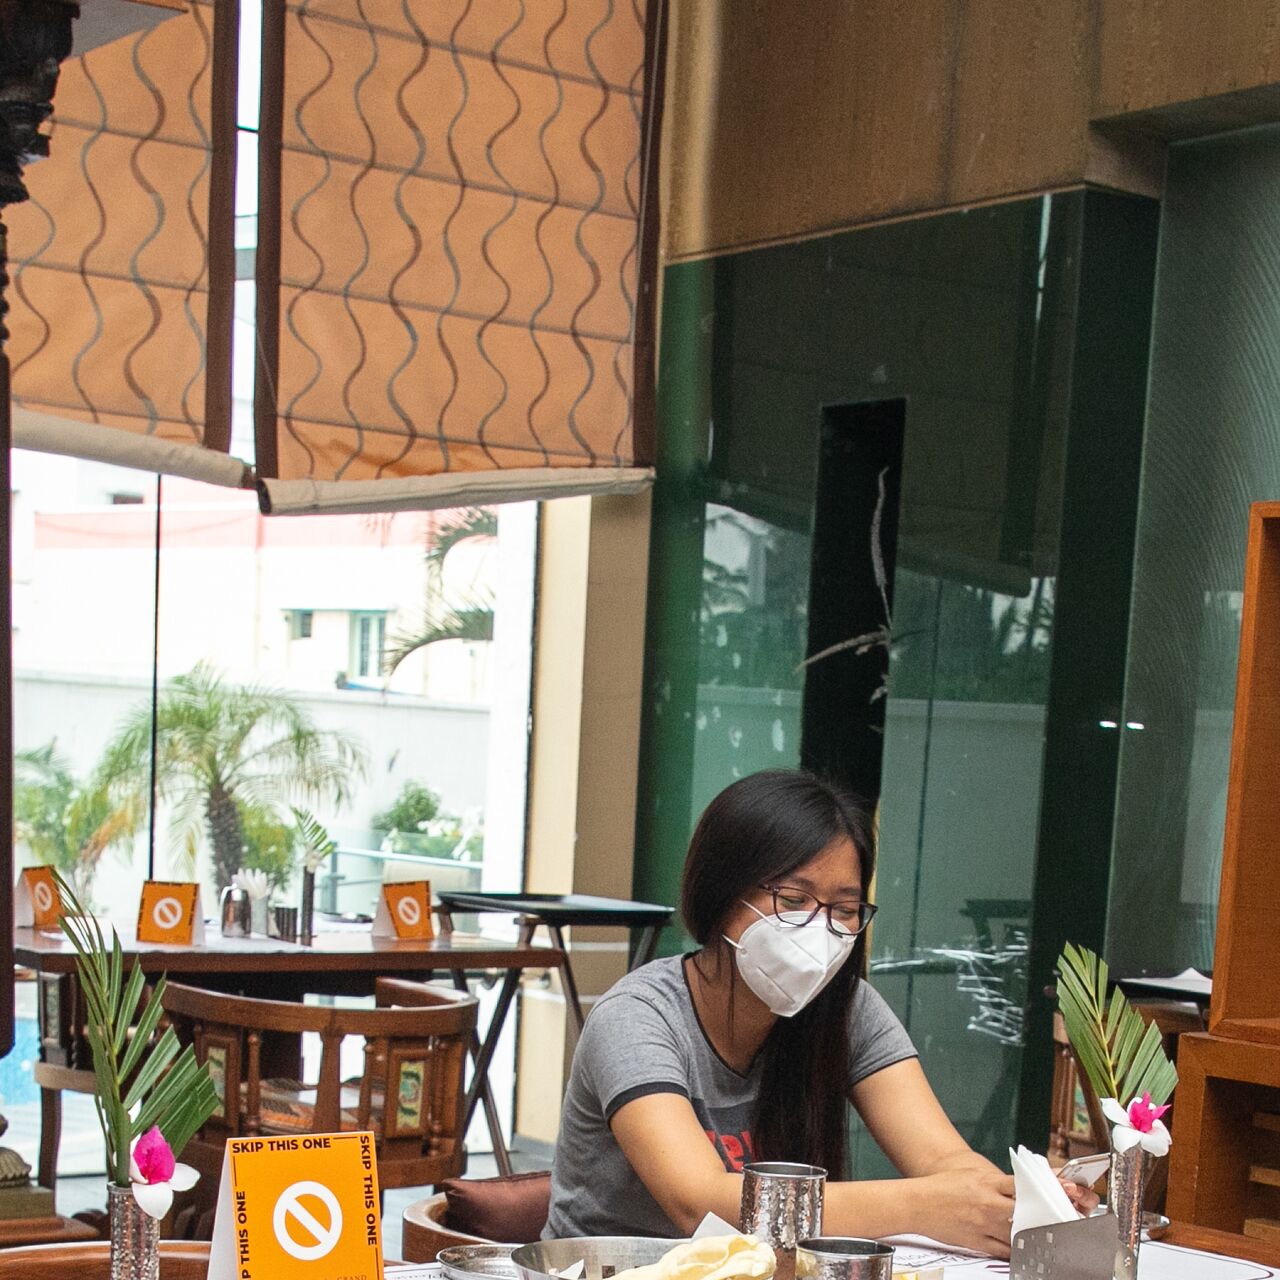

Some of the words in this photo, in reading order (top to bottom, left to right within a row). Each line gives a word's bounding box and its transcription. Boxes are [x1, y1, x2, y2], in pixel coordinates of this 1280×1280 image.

[232, 1142, 263, 1153] SKIP
[268, 1140, 299, 1151] THIS
[302, 1138, 331, 1149] ONE
[360, 1135, 371, 1170] SKIP
[236, 1191, 247, 1224] ONE
[363, 1174, 375, 1209] THIS
[366, 1213, 377, 1246] ONE
[239, 1229, 250, 1265] THIS
